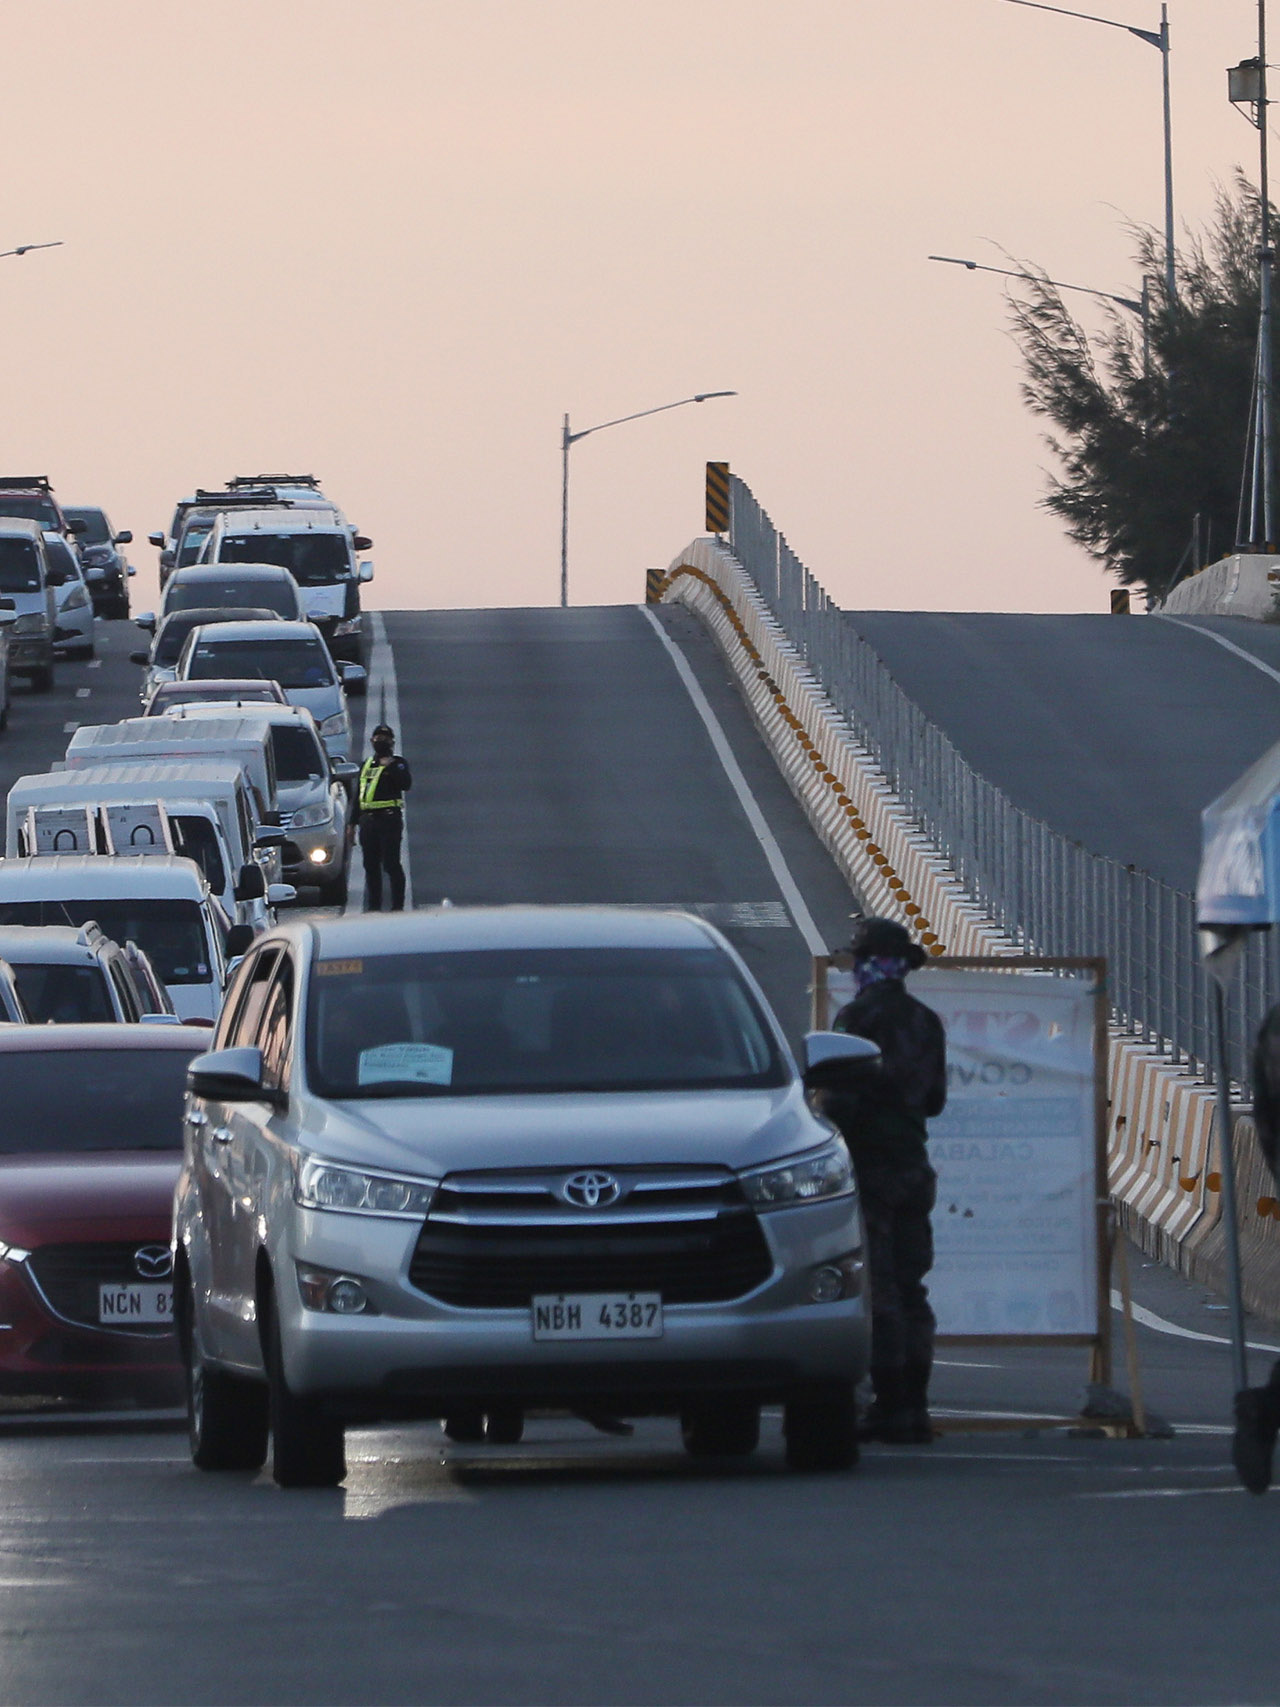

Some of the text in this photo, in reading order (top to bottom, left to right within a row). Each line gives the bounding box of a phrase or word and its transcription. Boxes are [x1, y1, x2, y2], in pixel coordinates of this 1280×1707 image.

[103, 1292, 141, 1315] NCN
[537, 1303, 658, 1330] NBH 4387
